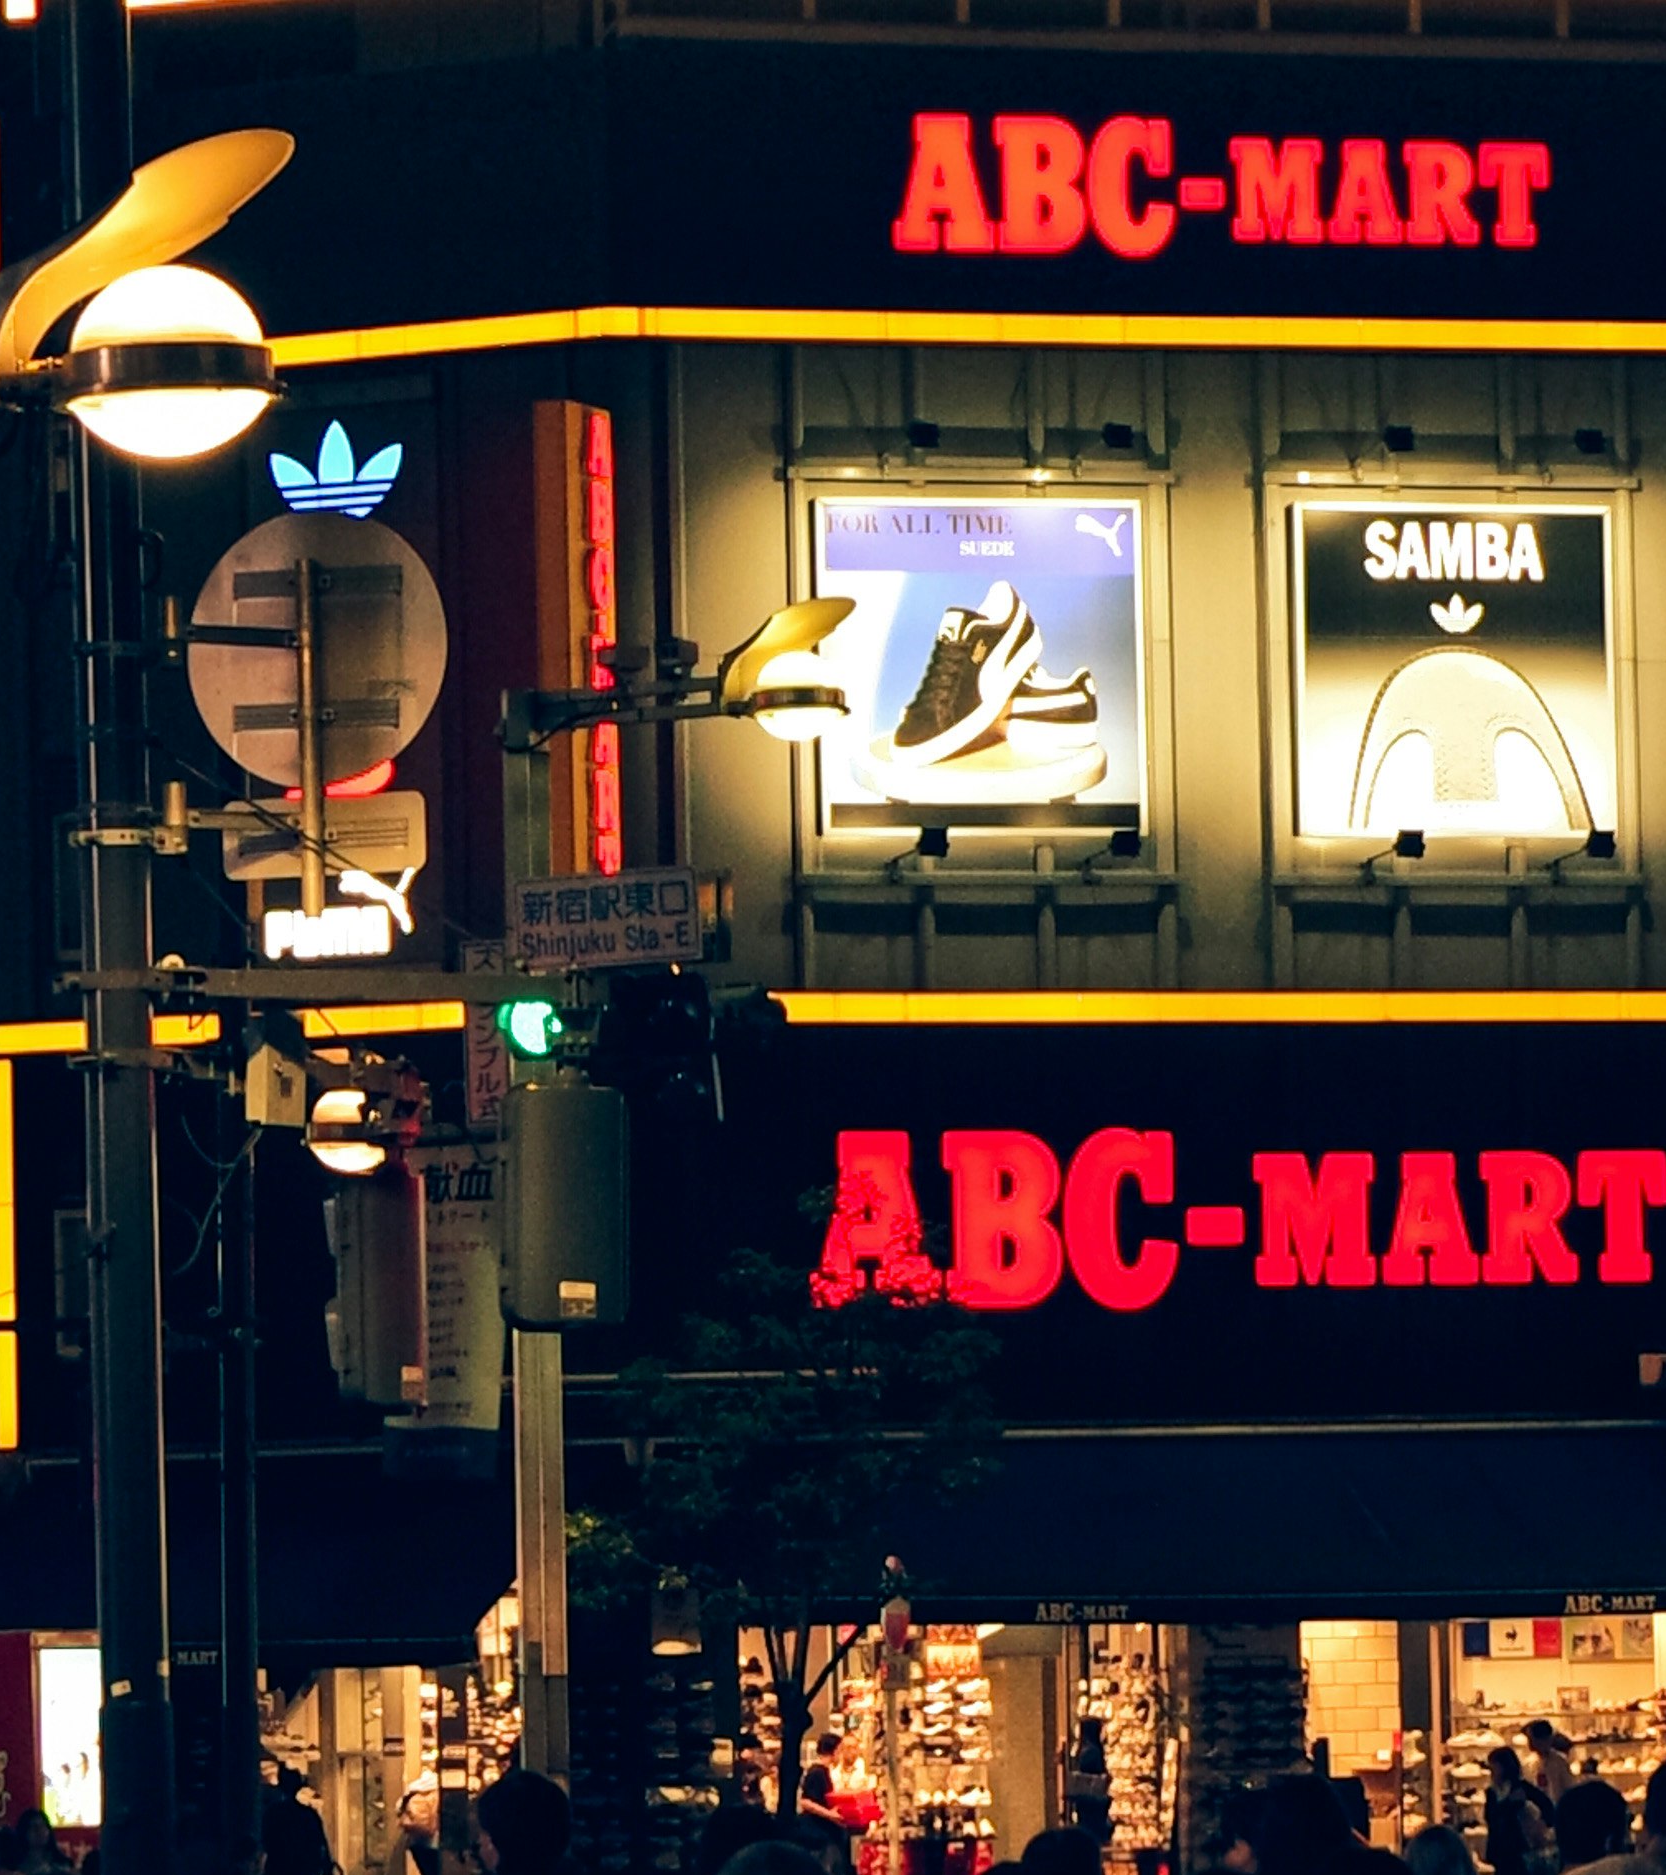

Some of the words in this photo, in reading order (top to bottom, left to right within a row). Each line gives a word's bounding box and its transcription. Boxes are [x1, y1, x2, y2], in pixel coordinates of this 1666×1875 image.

[893, 113, 1551, 257] ABC-MART
[827, 513, 879, 535] FOR
[890, 513, 941, 535] ALL
[945, 513, 1014, 535] TIME
[959, 541, 1015, 557] SUEDE
[1363, 519, 1545, 582] SAMBA
[523, 880, 689, 926] 新宿駅東口
[523, 932, 616, 960] Shinjuku
[1035, 1601, 1129, 1622] ABC-MART
[1562, 1594, 1657, 1614] ABC-MART
